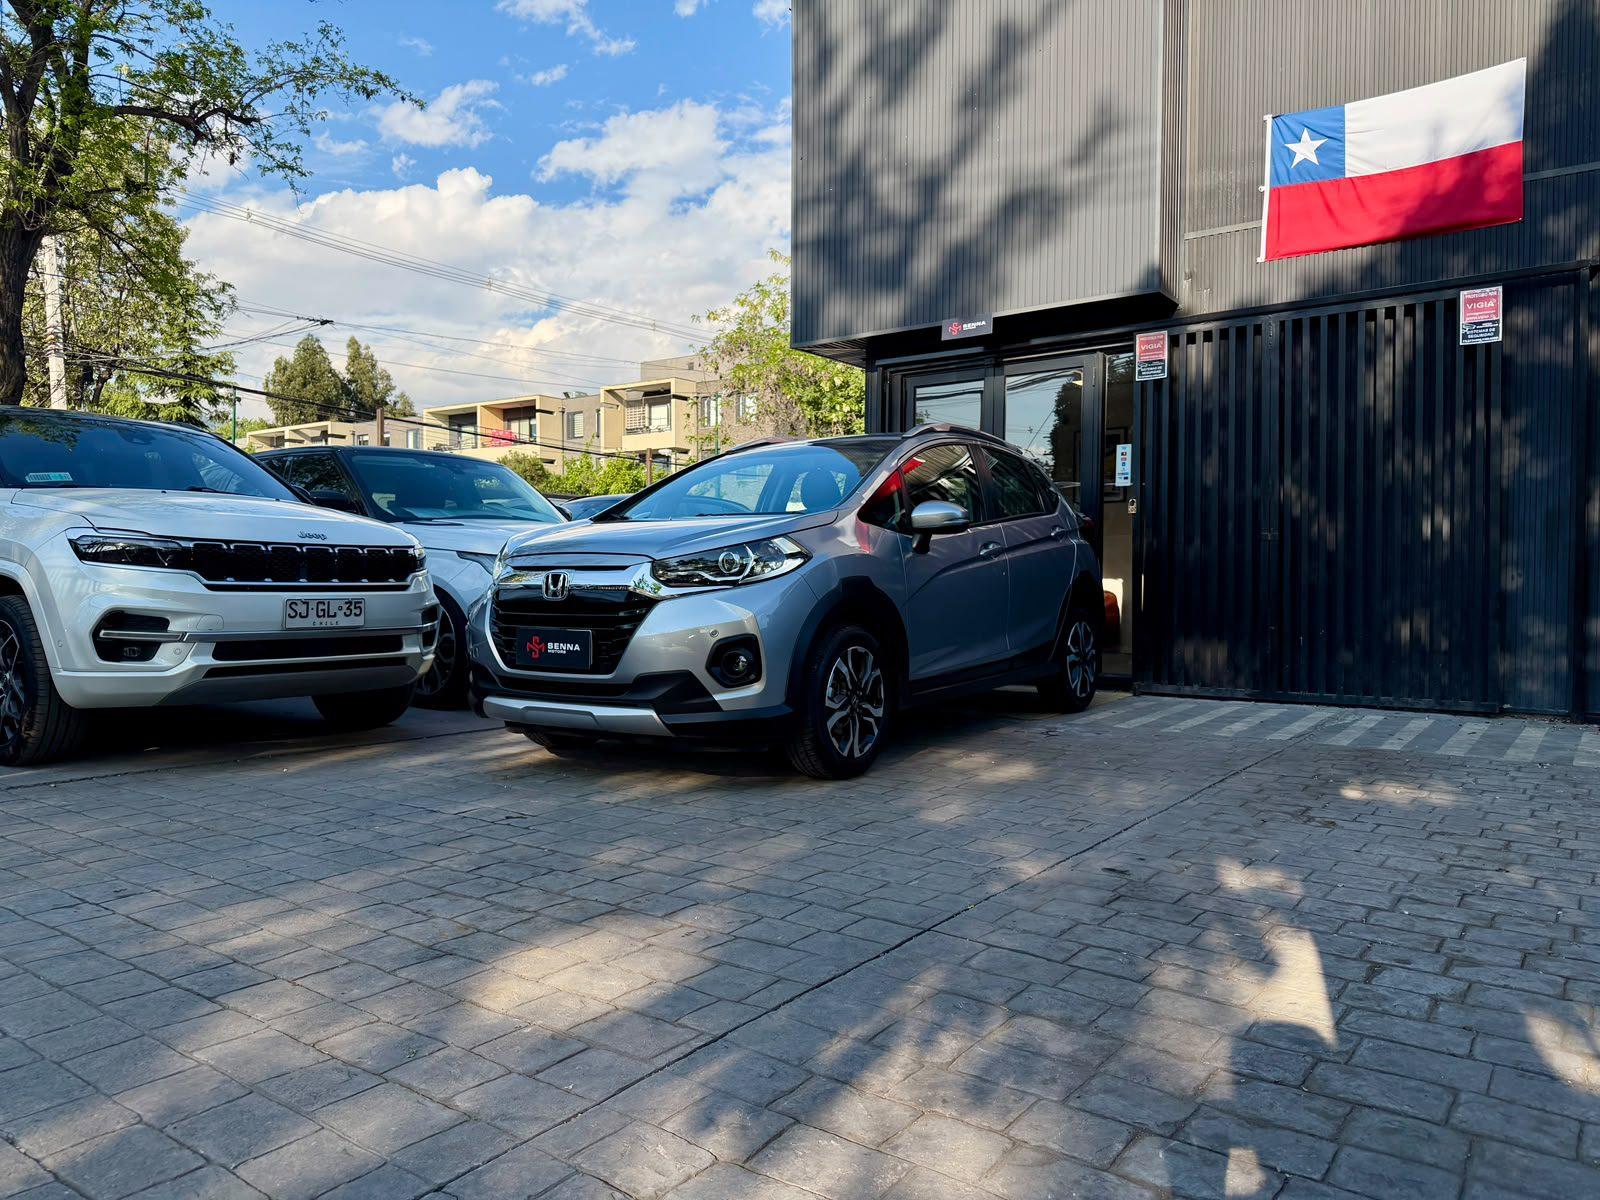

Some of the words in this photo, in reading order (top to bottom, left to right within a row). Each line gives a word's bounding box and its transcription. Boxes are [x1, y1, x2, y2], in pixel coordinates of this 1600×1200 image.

[1466, 301, 1495, 309] VIGIA
[297, 531, 327, 540] Jeep
[547, 642, 580, 651] SENNA
